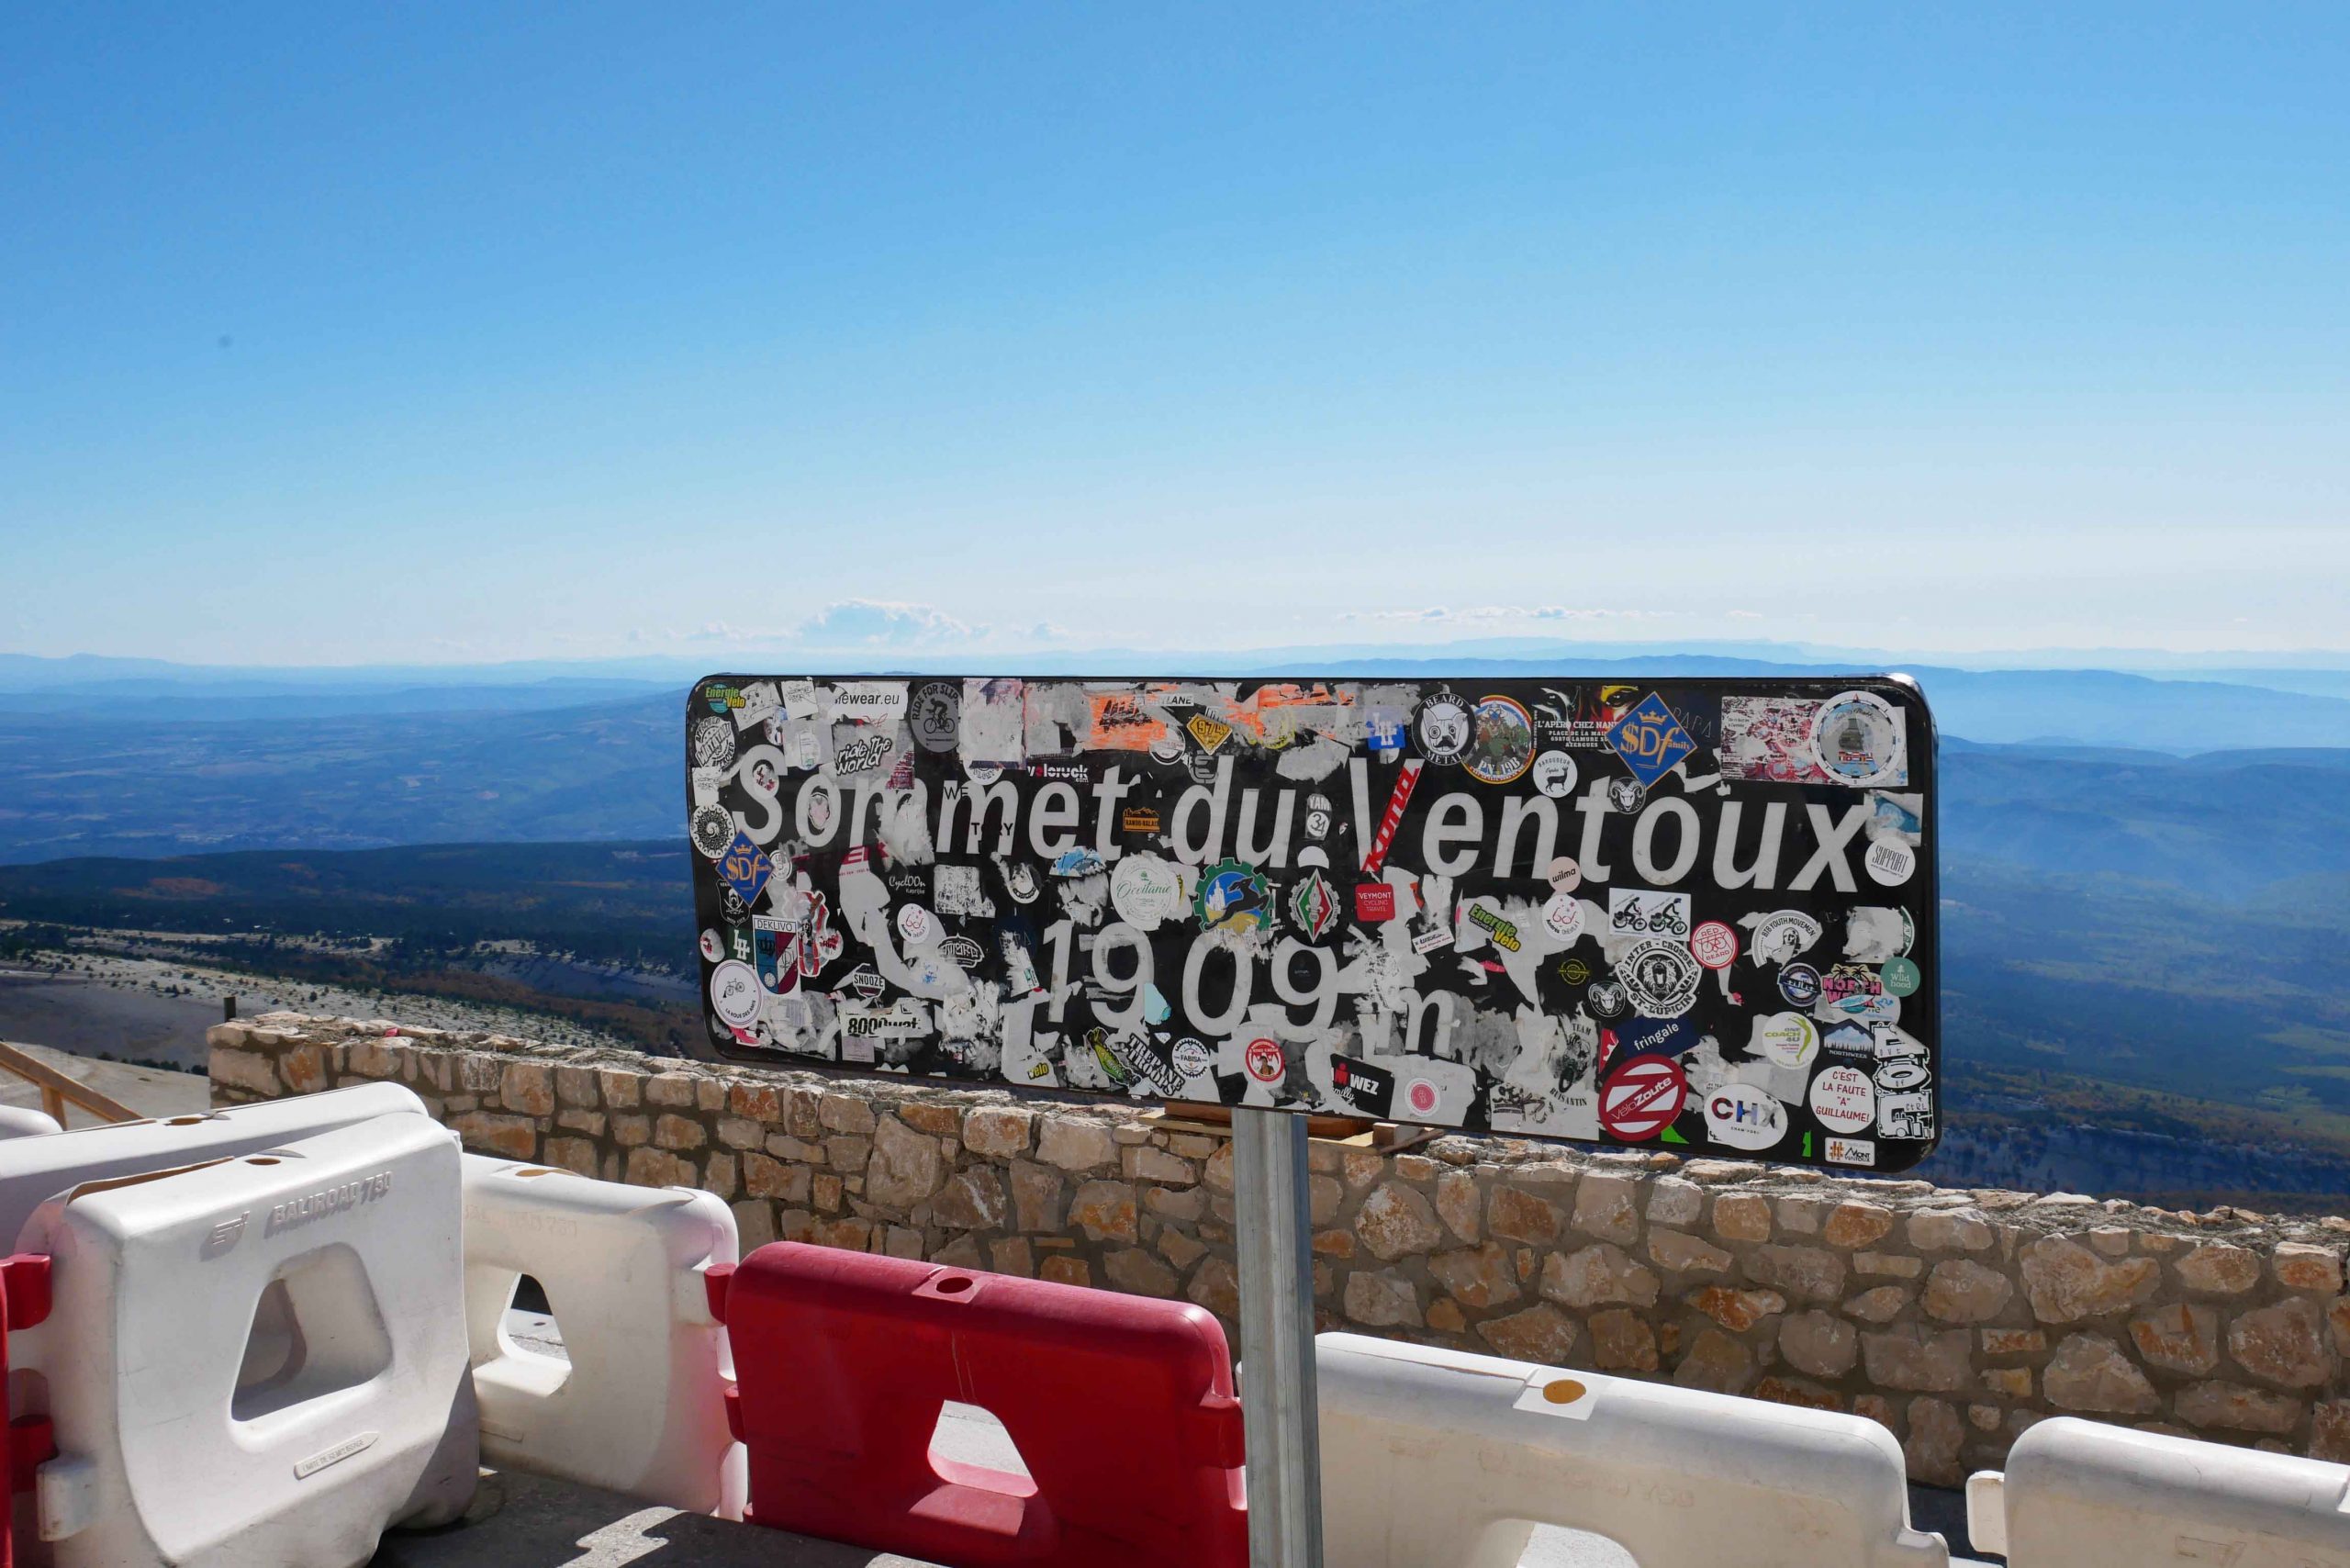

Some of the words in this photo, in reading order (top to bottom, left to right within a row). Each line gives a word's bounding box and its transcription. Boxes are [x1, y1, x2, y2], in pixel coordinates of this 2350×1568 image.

[912, 700, 924, 721] RIDE
[922, 684, 939, 701] FOR
[1425, 693, 1465, 709] BEARD
[1573, 721, 1595, 729] CHEZ
[1424, 750, 1467, 765] METAL
[1171, 755, 1297, 868] du
[1348, 757, 1867, 893] Ventoux
[1873, 845, 1908, 874] SUPPORT
[1552, 868, 1577, 883] wilma
[1358, 891, 1392, 900] VEYMONT
[756, 921, 793, 931] DEKLIVO
[1469, 903, 1518, 936] Energie
[1770, 917, 1788, 929] YOUTH
[1700, 926, 1719, 937] RED
[1624, 941, 1652, 968] INTER
[1662, 940, 1694, 968] CROSSE
[1705, 949, 1730, 961] BEARD
[854, 973, 884, 988] SNOOZE
[1043, 919, 1338, 1042] 1909
[1572, 1023, 1592, 1036] TEAM
[1633, 1022, 1680, 1051] fringale
[1349, 1072, 1380, 1095] WEZ
[1832, 1070, 1859, 1082] C'EST
[1822, 1081, 1834, 1092] LA
[1837, 1084, 1867, 1096] FAUTE
[1815, 1105, 1870, 1123] GUILLAUME!
